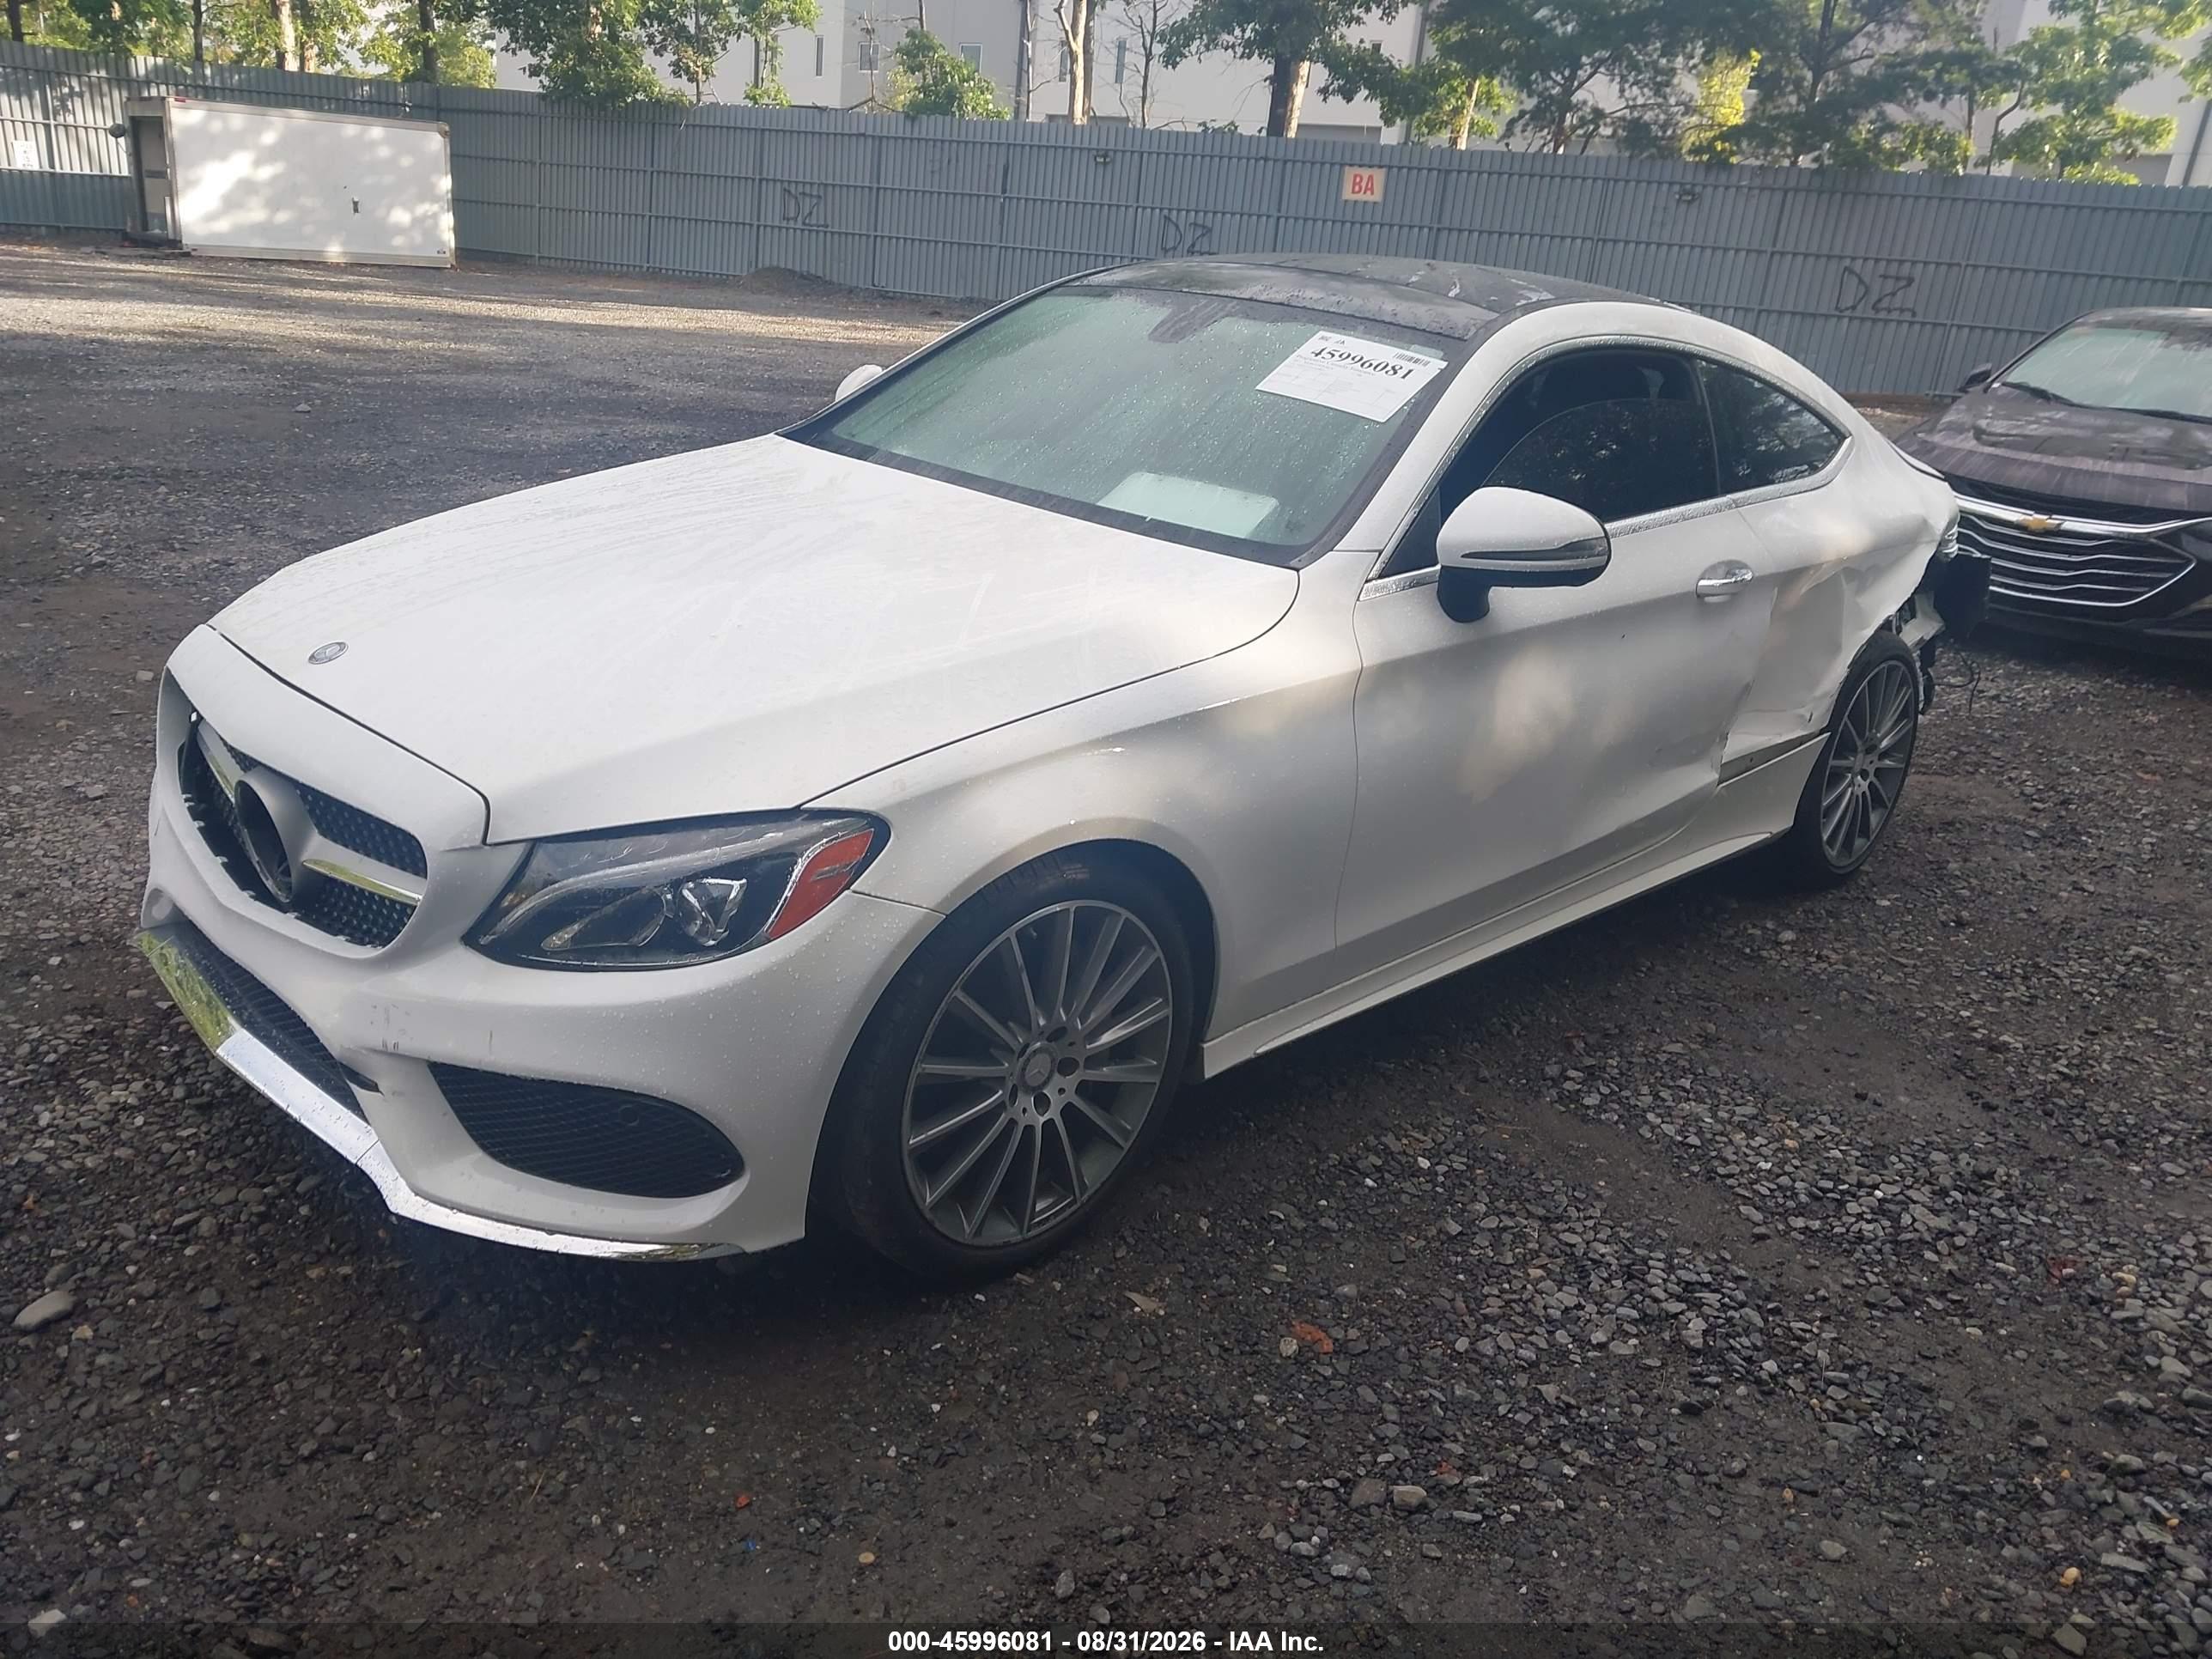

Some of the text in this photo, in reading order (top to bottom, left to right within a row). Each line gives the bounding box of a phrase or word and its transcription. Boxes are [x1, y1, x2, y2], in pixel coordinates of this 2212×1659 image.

[1352, 173, 1375, 196] BA
[782, 187, 830, 228] DZ
[1161, 214, 1218, 255] DZ
[1835, 265, 1917, 318] DZ
[1310, 346, 1415, 380] 45996081
